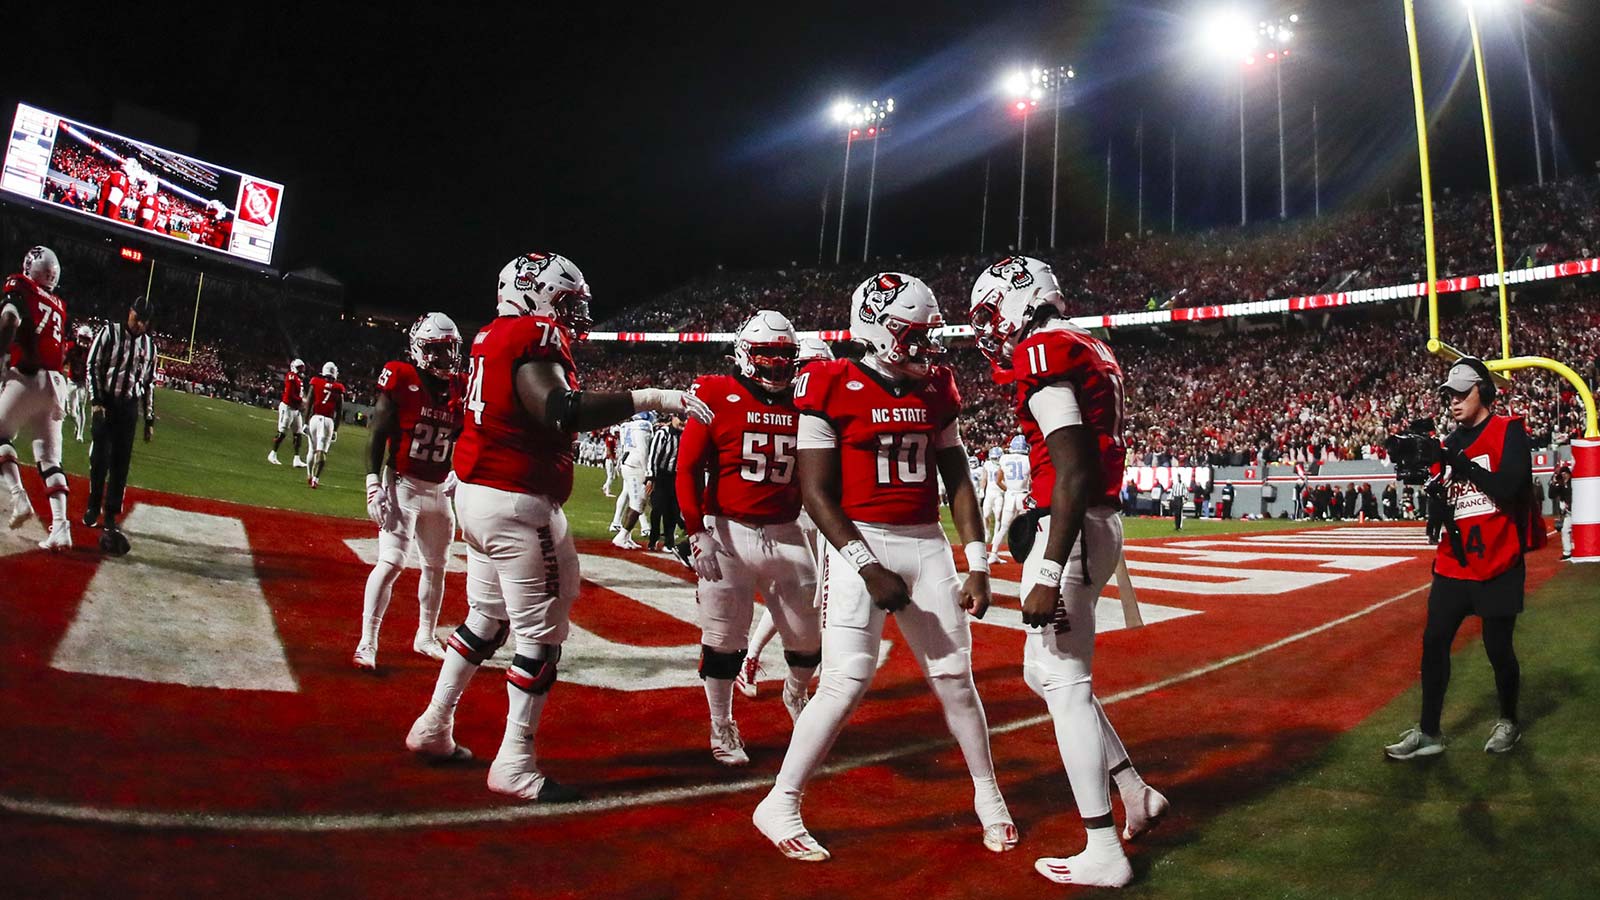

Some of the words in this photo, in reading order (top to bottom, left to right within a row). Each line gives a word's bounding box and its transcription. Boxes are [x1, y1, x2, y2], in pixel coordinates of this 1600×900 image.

[1479, 265, 1555, 288] TOUCHDOWN
[1346, 283, 1417, 303] TOUCHDOWN
[1223, 299, 1289, 317] TOUCHDOWN
[536, 321, 562, 351] 74
[1027, 343, 1048, 375] 11
[323, 389, 331, 404] 7
[420, 406, 433, 418] NC
[433, 409, 455, 424] STATE
[747, 411, 761, 424] NC
[763, 412, 793, 427] STATE
[871, 408, 890, 423] NC
[892, 407, 928, 423] STATE
[409, 422, 453, 463] 25
[740, 431, 797, 485] 55
[877, 432, 929, 484] 10
[1005, 461, 1024, 481] 31
[536, 523, 560, 599] WOLFPACK
